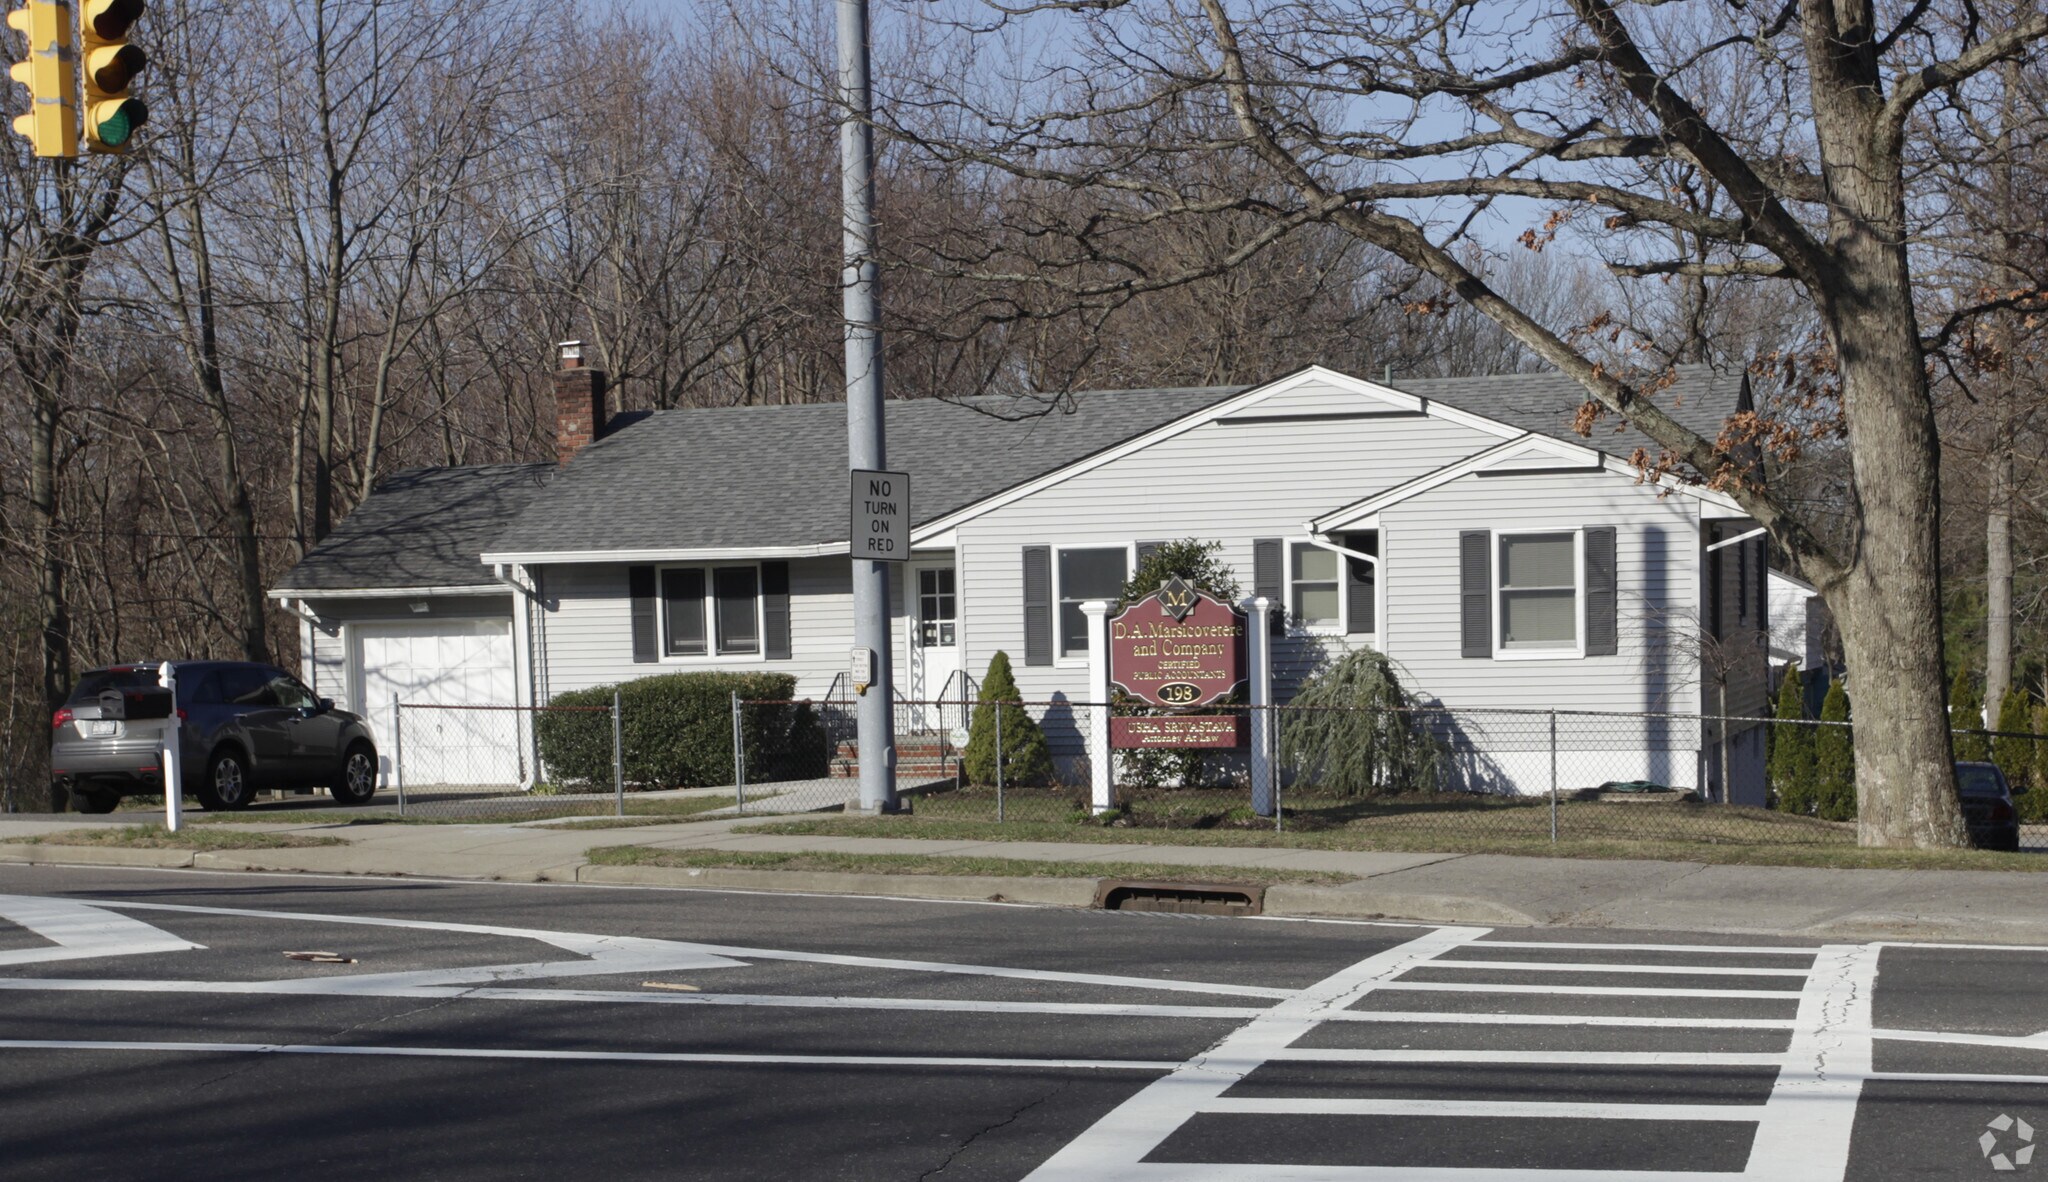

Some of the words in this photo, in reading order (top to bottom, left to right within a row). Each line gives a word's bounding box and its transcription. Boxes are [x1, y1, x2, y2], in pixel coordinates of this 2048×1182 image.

[869, 480, 892, 497] NO
[864, 501, 897, 516] TURN
[871, 520, 890, 534] ON
[868, 537, 894, 552] RED
[1166, 589, 1187, 607] M
[1133, 640, 1157, 656] and
[1162, 638, 1224, 659] Company
[1157, 660, 1201, 670] CERTIFIED
[1133, 672, 1162, 681] PUBLIC
[1164, 671, 1226, 681] ACCOUNTANTS
[1166, 686, 1193, 701] 198
[1128, 722, 1161, 733] USHA
[1164, 722, 1235, 733] SRIVASTAVA
[1142, 734, 1181, 744] Attorney
[1199, 734, 1219, 742] Law
